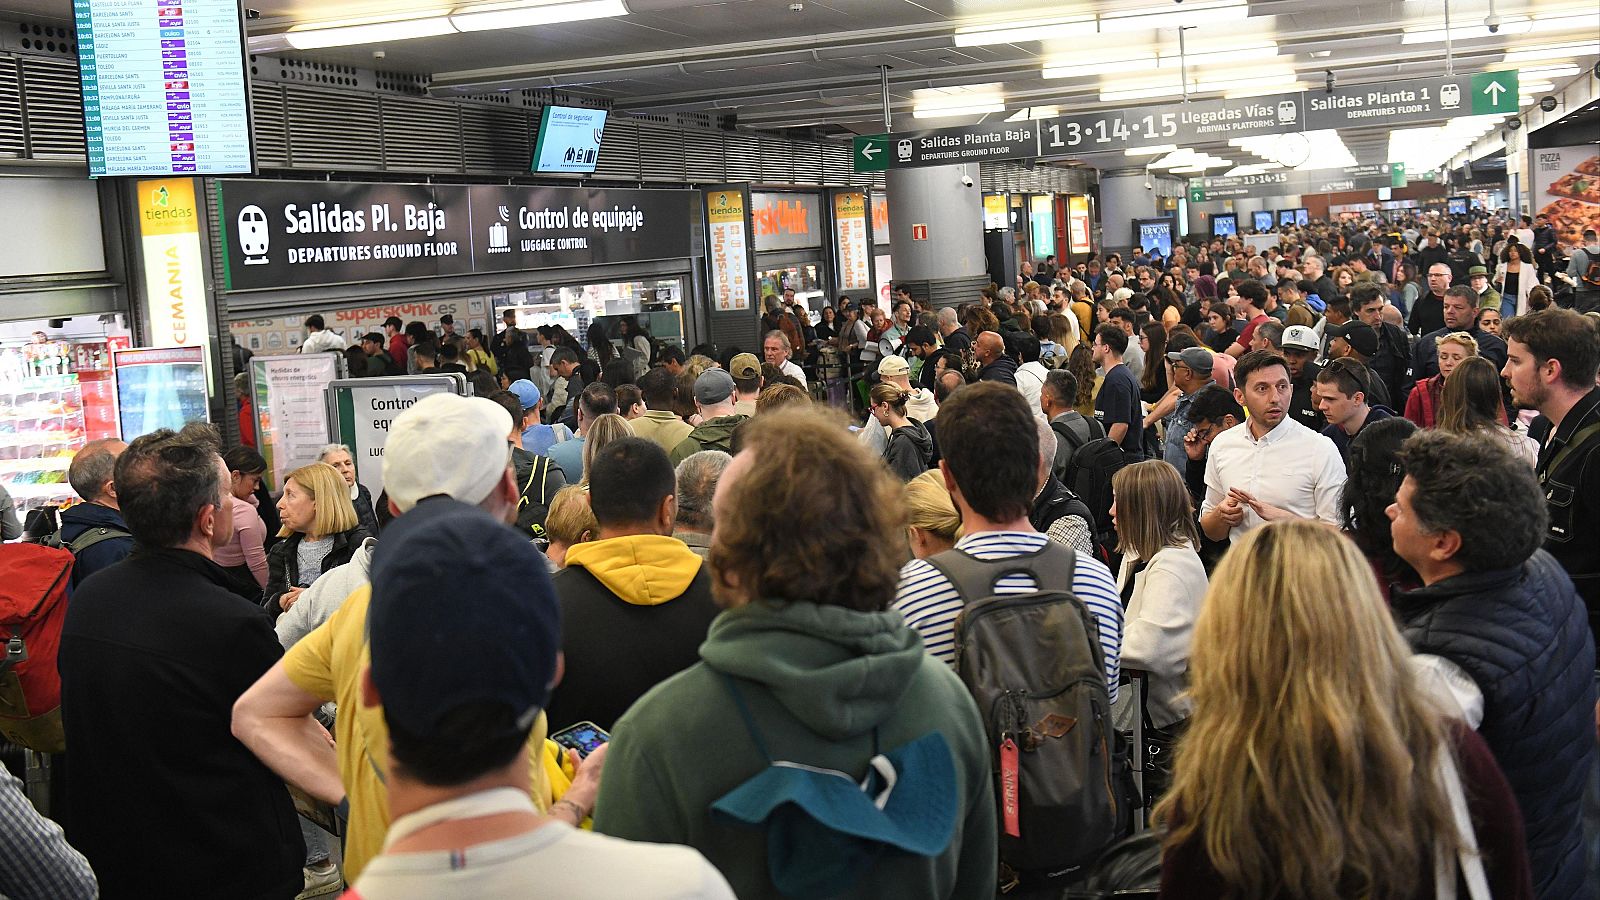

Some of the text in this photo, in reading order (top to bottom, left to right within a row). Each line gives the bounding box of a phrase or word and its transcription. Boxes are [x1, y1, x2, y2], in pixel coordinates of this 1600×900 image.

[1311, 87, 1430, 110] Salidas Planta 1
[1181, 103, 1274, 124] Llegadas Vías
[1347, 104, 1430, 119] DEPARTURES FLOOR 1
[1196, 119, 1274, 133] ARRIVALS PLATFORMS
[920, 128, 1031, 149] Salidas Planta Baja
[921, 146, 1010, 161] DEPARTURES GROUND FLOOR
[1540, 152, 1560, 162] PIZZA
[1541, 163, 1560, 171] TIME!
[145, 206, 192, 220] tiendas
[710, 206, 742, 215] tiendas
[837, 204, 864, 212] tiendas
[285, 202, 446, 237] Salidas Pl. Baja
[519, 205, 643, 233] Control de equipaje
[521, 237, 587, 252] LUGGAGE CONTROL
[288, 242, 458, 264] DEPARTURES GROUND FLOOR
